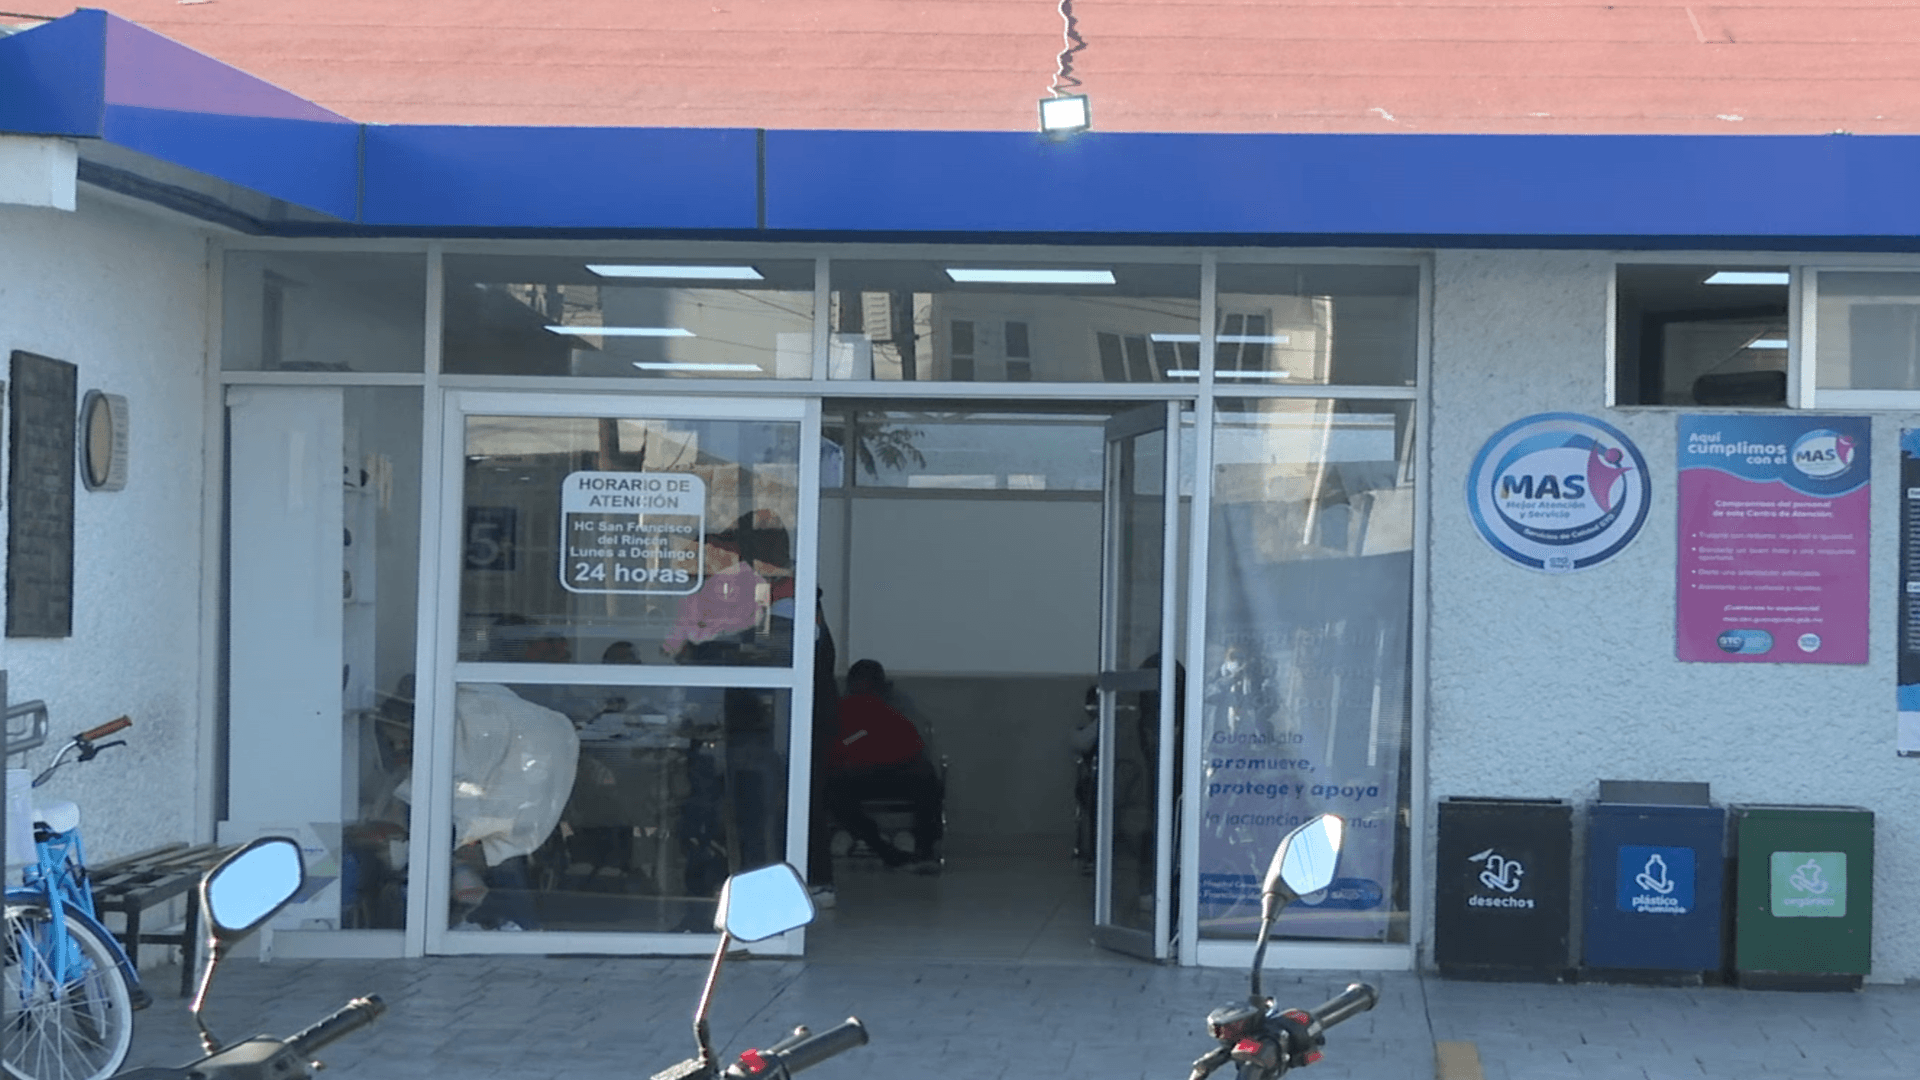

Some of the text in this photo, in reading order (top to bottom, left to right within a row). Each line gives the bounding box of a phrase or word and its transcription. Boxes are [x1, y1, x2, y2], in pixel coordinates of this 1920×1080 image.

[1689, 431, 1721, 443] Aquí
[1687, 441, 1787, 457] cumplimos
[1796, 448, 1836, 463] MAS
[1746, 455, 1788, 465] con el
[579, 477, 690, 492] HORARIO DE
[1500, 474, 1586, 500] MAS
[588, 494, 679, 509] ATENCIÓN
[1505, 500, 1586, 510] Mejor Atención
[1528, 510, 1571, 519] Servicio
[574, 521, 693, 534] HC San Francisco
[597, 535, 618, 545] del
[570, 546, 696, 561] Lunes a Domingo
[574, 562, 690, 583] 24 horas
[1209, 780, 1379, 801] protege y apoya
[1468, 894, 1535, 909] desechos
[1631, 894, 1679, 907] plástico
